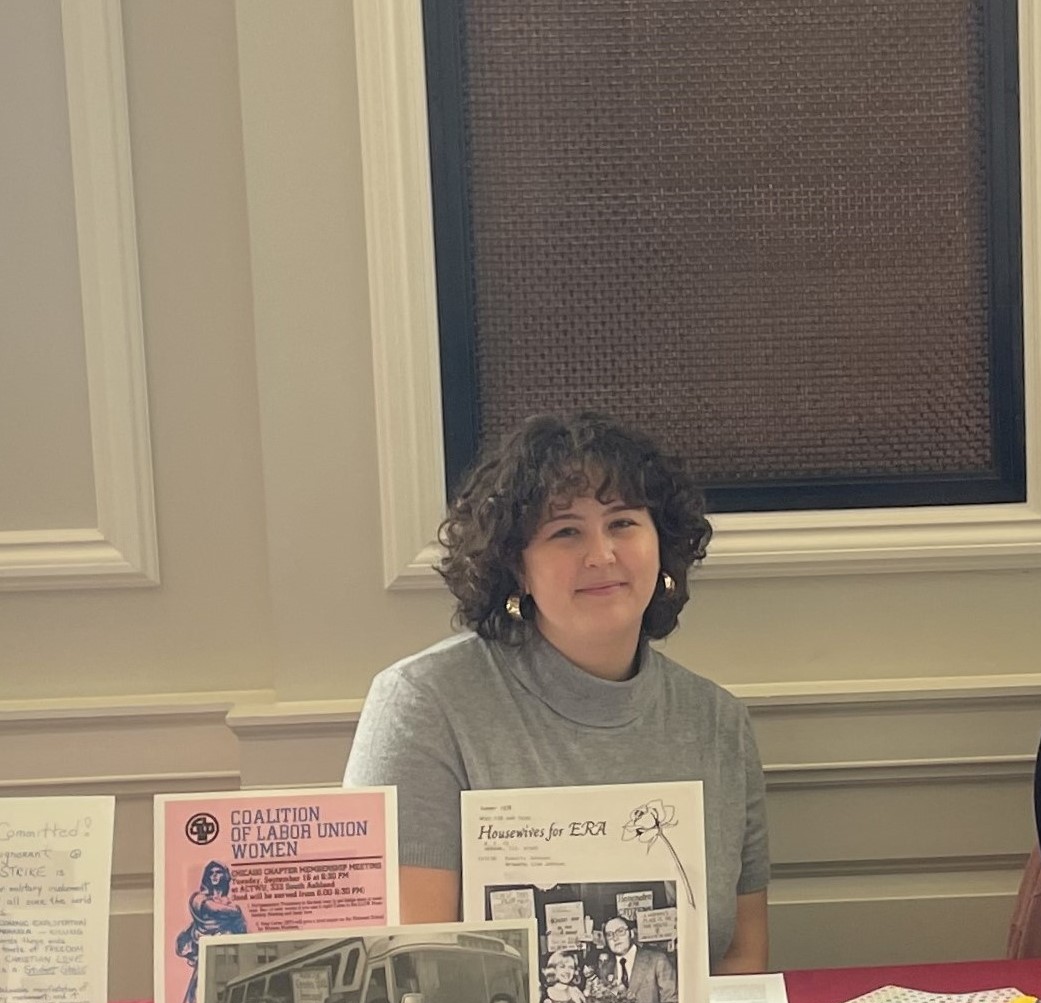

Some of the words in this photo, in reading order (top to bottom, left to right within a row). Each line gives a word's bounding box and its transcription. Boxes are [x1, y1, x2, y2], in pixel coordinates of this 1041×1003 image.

[231, 806, 320, 825] COALITION
[231, 826, 251, 842] OF
[256, 824, 312, 841] LABOR
[317, 820, 368, 838] UNION
[478, 823, 545, 840] Housewives
[545, 822, 564, 841] for
[568, 820, 607, 837] ERA
[231, 841, 298, 859] WOMEN
[264, 866, 298, 876] CHAPTER
[349, 862, 382, 871] MEETING
